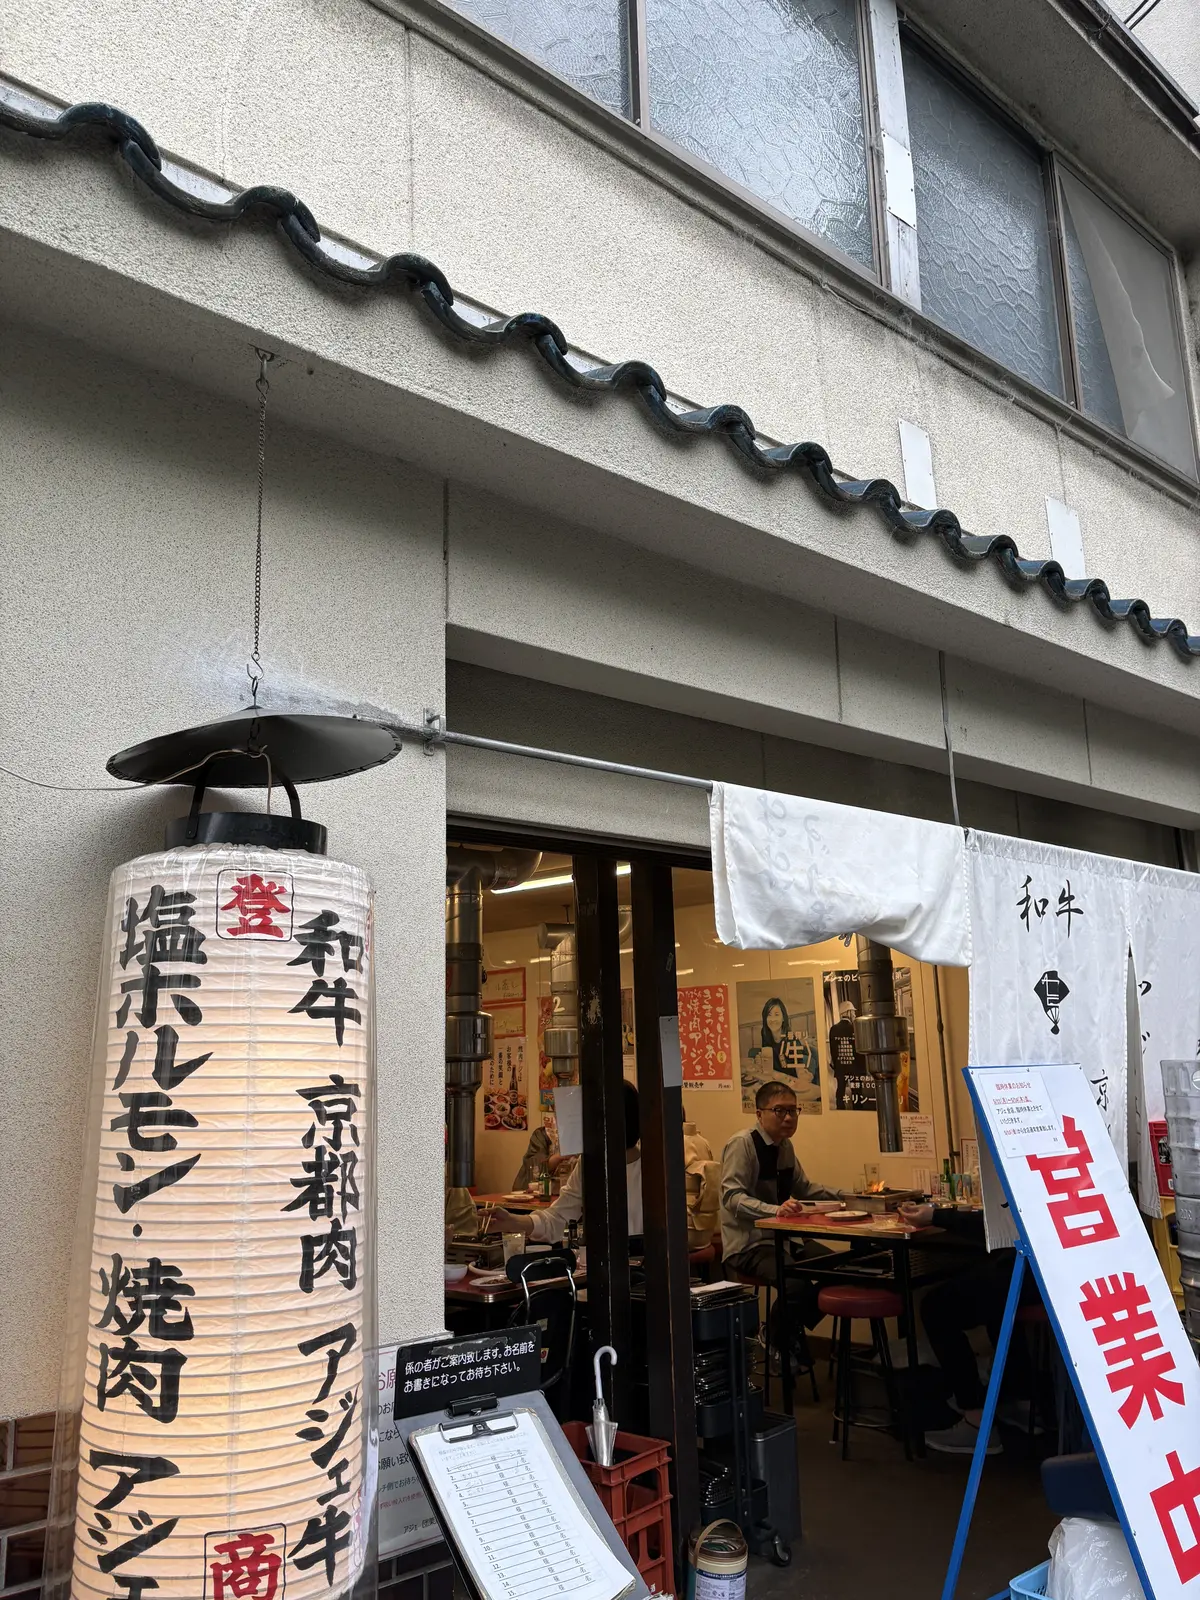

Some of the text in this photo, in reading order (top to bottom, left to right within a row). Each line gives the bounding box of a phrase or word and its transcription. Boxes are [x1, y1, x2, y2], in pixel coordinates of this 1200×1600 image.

[220, 873, 291, 938] 登
[1016, 875, 1084, 938] 和牛
[286, 910, 364, 1047] 和牛
[553, 996, 566, 1012] 2
[823, 974, 860, 983] アジェのビ
[280, 1074, 361, 1293] 京都肉
[404, 1361, 521, 1393] お書きになってお待ち下さい。
[405, 1341, 535, 1375] 係の者がご案内致します。お名前を
[1025, 1115, 1200, 1585] 営業中
[209, 1533, 282, 1600] 商
